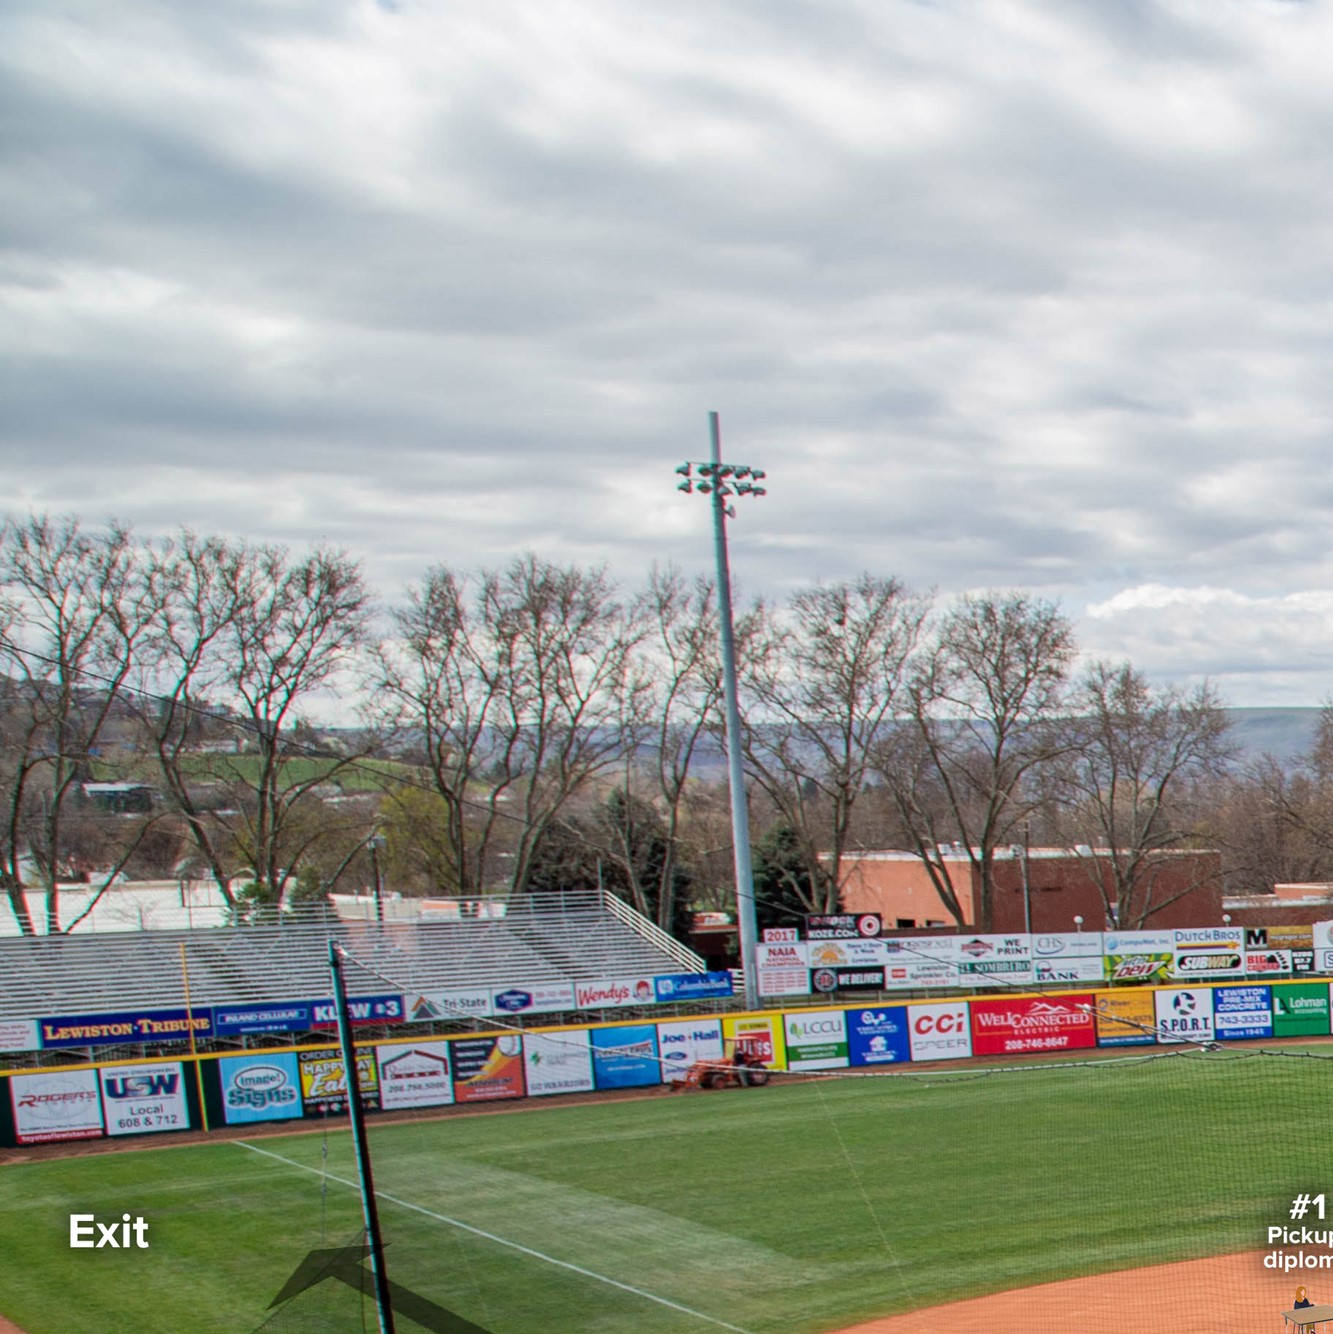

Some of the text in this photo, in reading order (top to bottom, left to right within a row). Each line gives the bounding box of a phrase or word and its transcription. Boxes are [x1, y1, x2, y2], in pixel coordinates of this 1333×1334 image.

[767, 931, 796, 942] 2017
[1175, 930, 1241, 942] DUTCH BROS
[1037, 936, 1064, 949] CHS
[768, 948, 797, 956] NAIA
[997, 946, 1029, 955] PRINT
[1182, 955, 1238, 970] SUBWAY
[1247, 955, 1267, 964] BIG
[1037, 971, 1080, 981] BANK
[577, 981, 630, 1007] Wendy's
[1217, 988, 1267, 997] LEWISTON
[1223, 996, 1262, 1004] PRE-MIX
[1289, 997, 1327, 1009] Lohman
[1217, 1002, 1268, 1011] CONCRETE
[1218, 1014, 1269, 1024] 743-3333
[44, 1023, 133, 1041] LEWISTON
[137, 1017, 211, 1035] TRIBUNE
[803, 1020, 842, 1035] LCCU
[1013, 1027, 1061, 1036] ELECTRIC
[661, 1029, 719, 1044] Joe Hall
[913, 1037, 968, 1050] SPEER
[105, 1073, 180, 1100] USW
[18, 1091, 97, 1107] ROGERS
[228, 1087, 296, 1109] Signs
[130, 1104, 164, 1116] Local
[118, 1114, 178, 1129] 608 & 712
